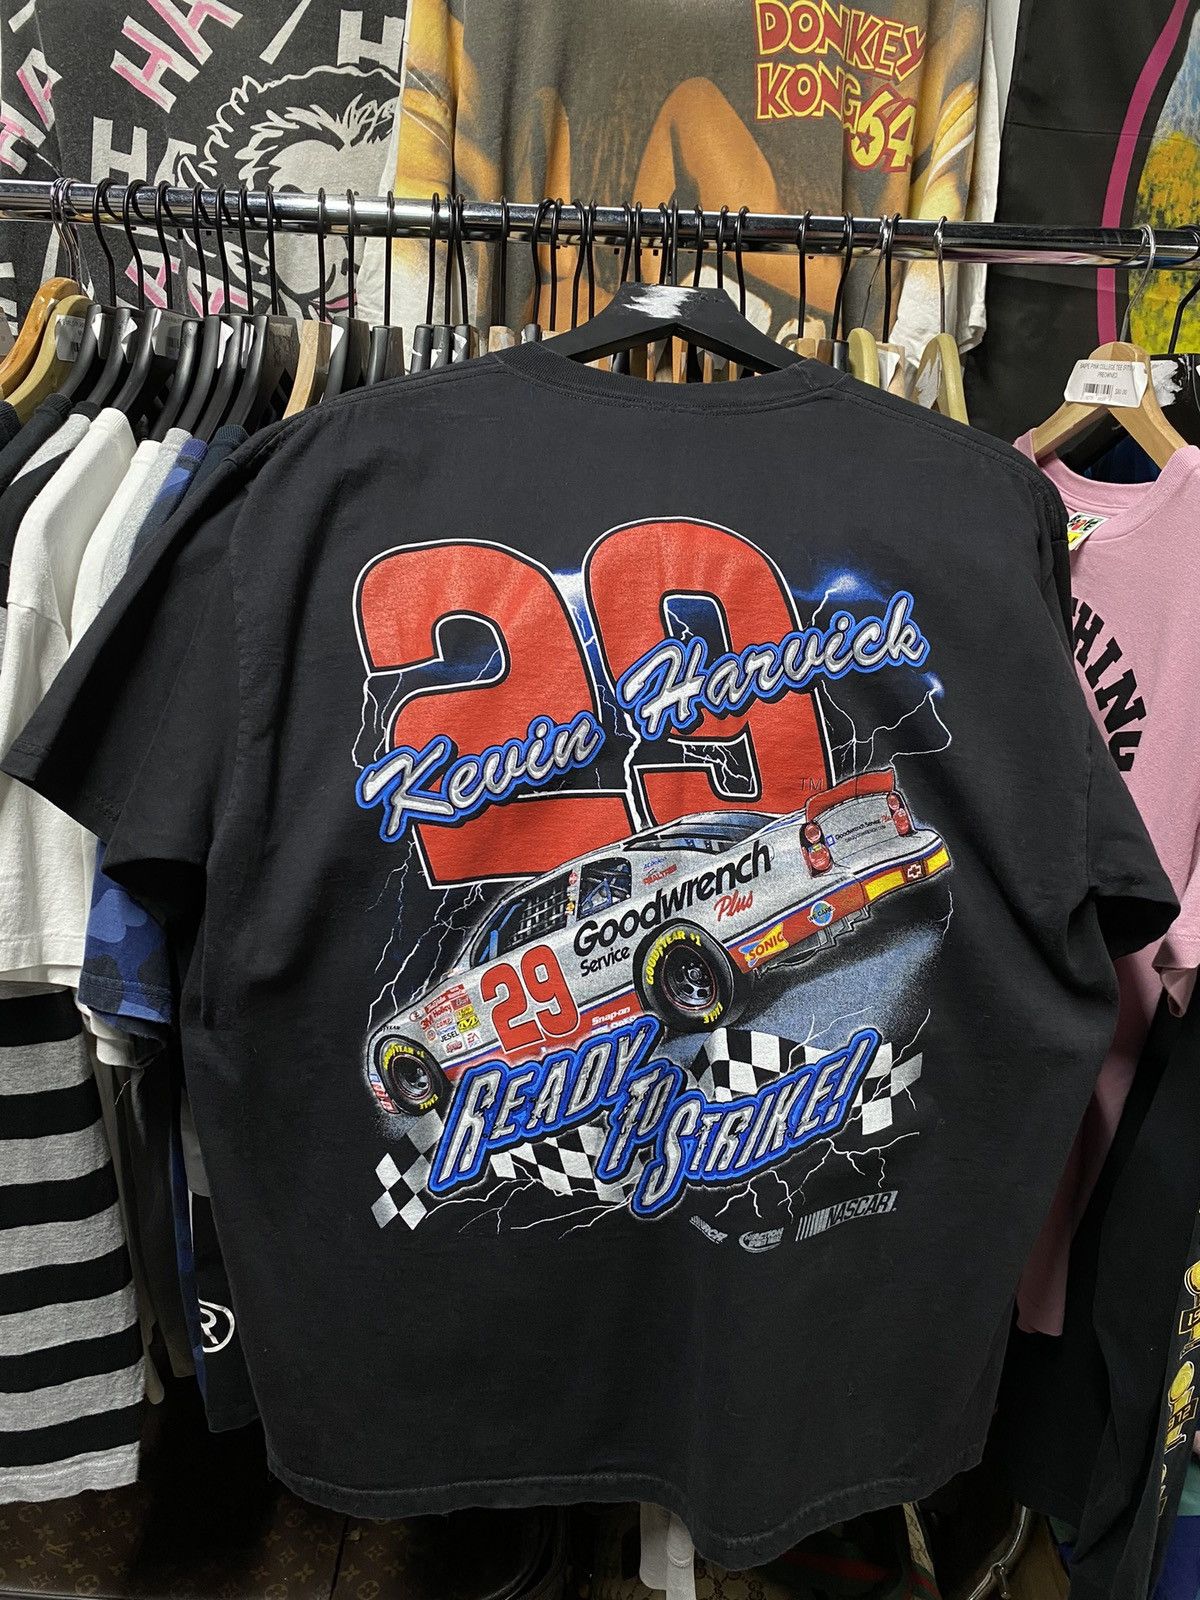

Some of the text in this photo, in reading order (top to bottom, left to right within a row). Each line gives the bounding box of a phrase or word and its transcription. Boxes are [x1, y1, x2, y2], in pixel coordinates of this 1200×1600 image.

[755, 0, 926, 82] DONKEY
[756, 60, 862, 134] KONG
[850, 88, 917, 169] 64
[354, 517, 837, 889] 29
[618, 592, 929, 738] Harvick
[1072, 597, 1147, 772] HING
[358, 711, 603, 840] Kevin
[573, 840, 771, 957] Goodwrench
[713, 889, 753, 922] Plus
[580, 945, 631, 977] Service
[645, 930, 687, 986] GOODYEAR
[748, 930, 785, 960] SONIC
[479, 943, 580, 1054] 29
[591, 1006, 631, 1026] Snap-on
[434, 1025, 652, 1189] READY
[606, 1064, 674, 1174] TO
[640, 1036, 875, 1211] STRIKE!
[827, 1191, 894, 1227] NASCAR
[1167, 1403, 1191, 1432] 972
